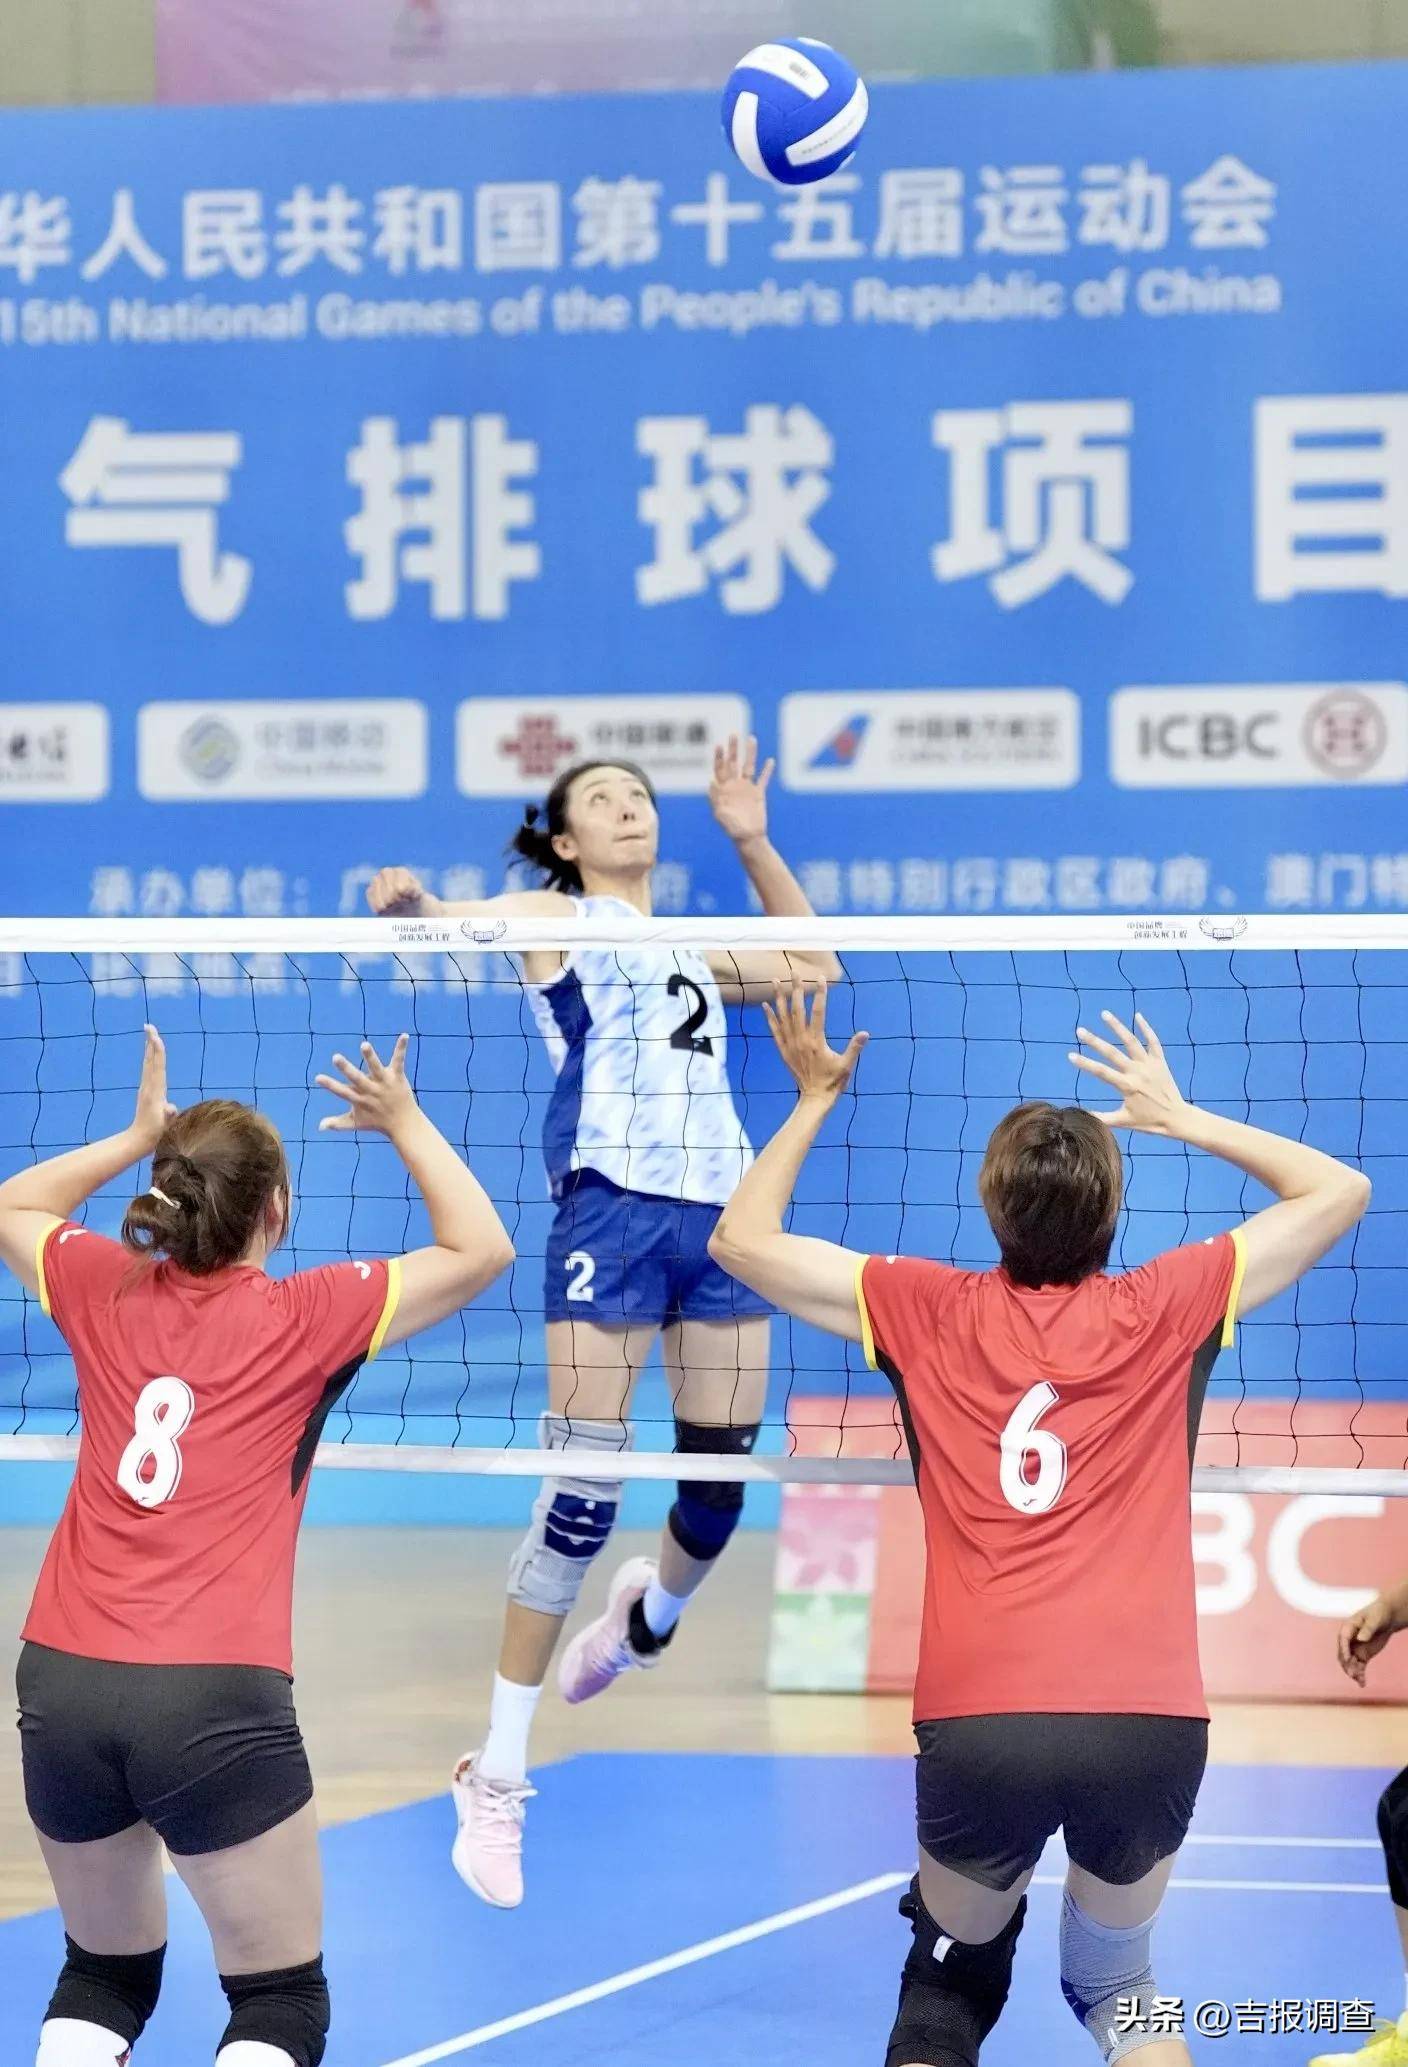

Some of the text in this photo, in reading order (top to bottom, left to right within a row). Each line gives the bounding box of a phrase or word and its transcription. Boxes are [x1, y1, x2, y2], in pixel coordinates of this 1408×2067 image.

[0, 265, 1282, 345] 15th National Games of the People's Republic of China
[1138, 711, 1281, 760] ICBC
[667, 973, 714, 1057] 2
[565, 1251, 596, 1302] 2
[117, 1376, 195, 1508] 8
[1000, 1380, 1068, 1514] 6
